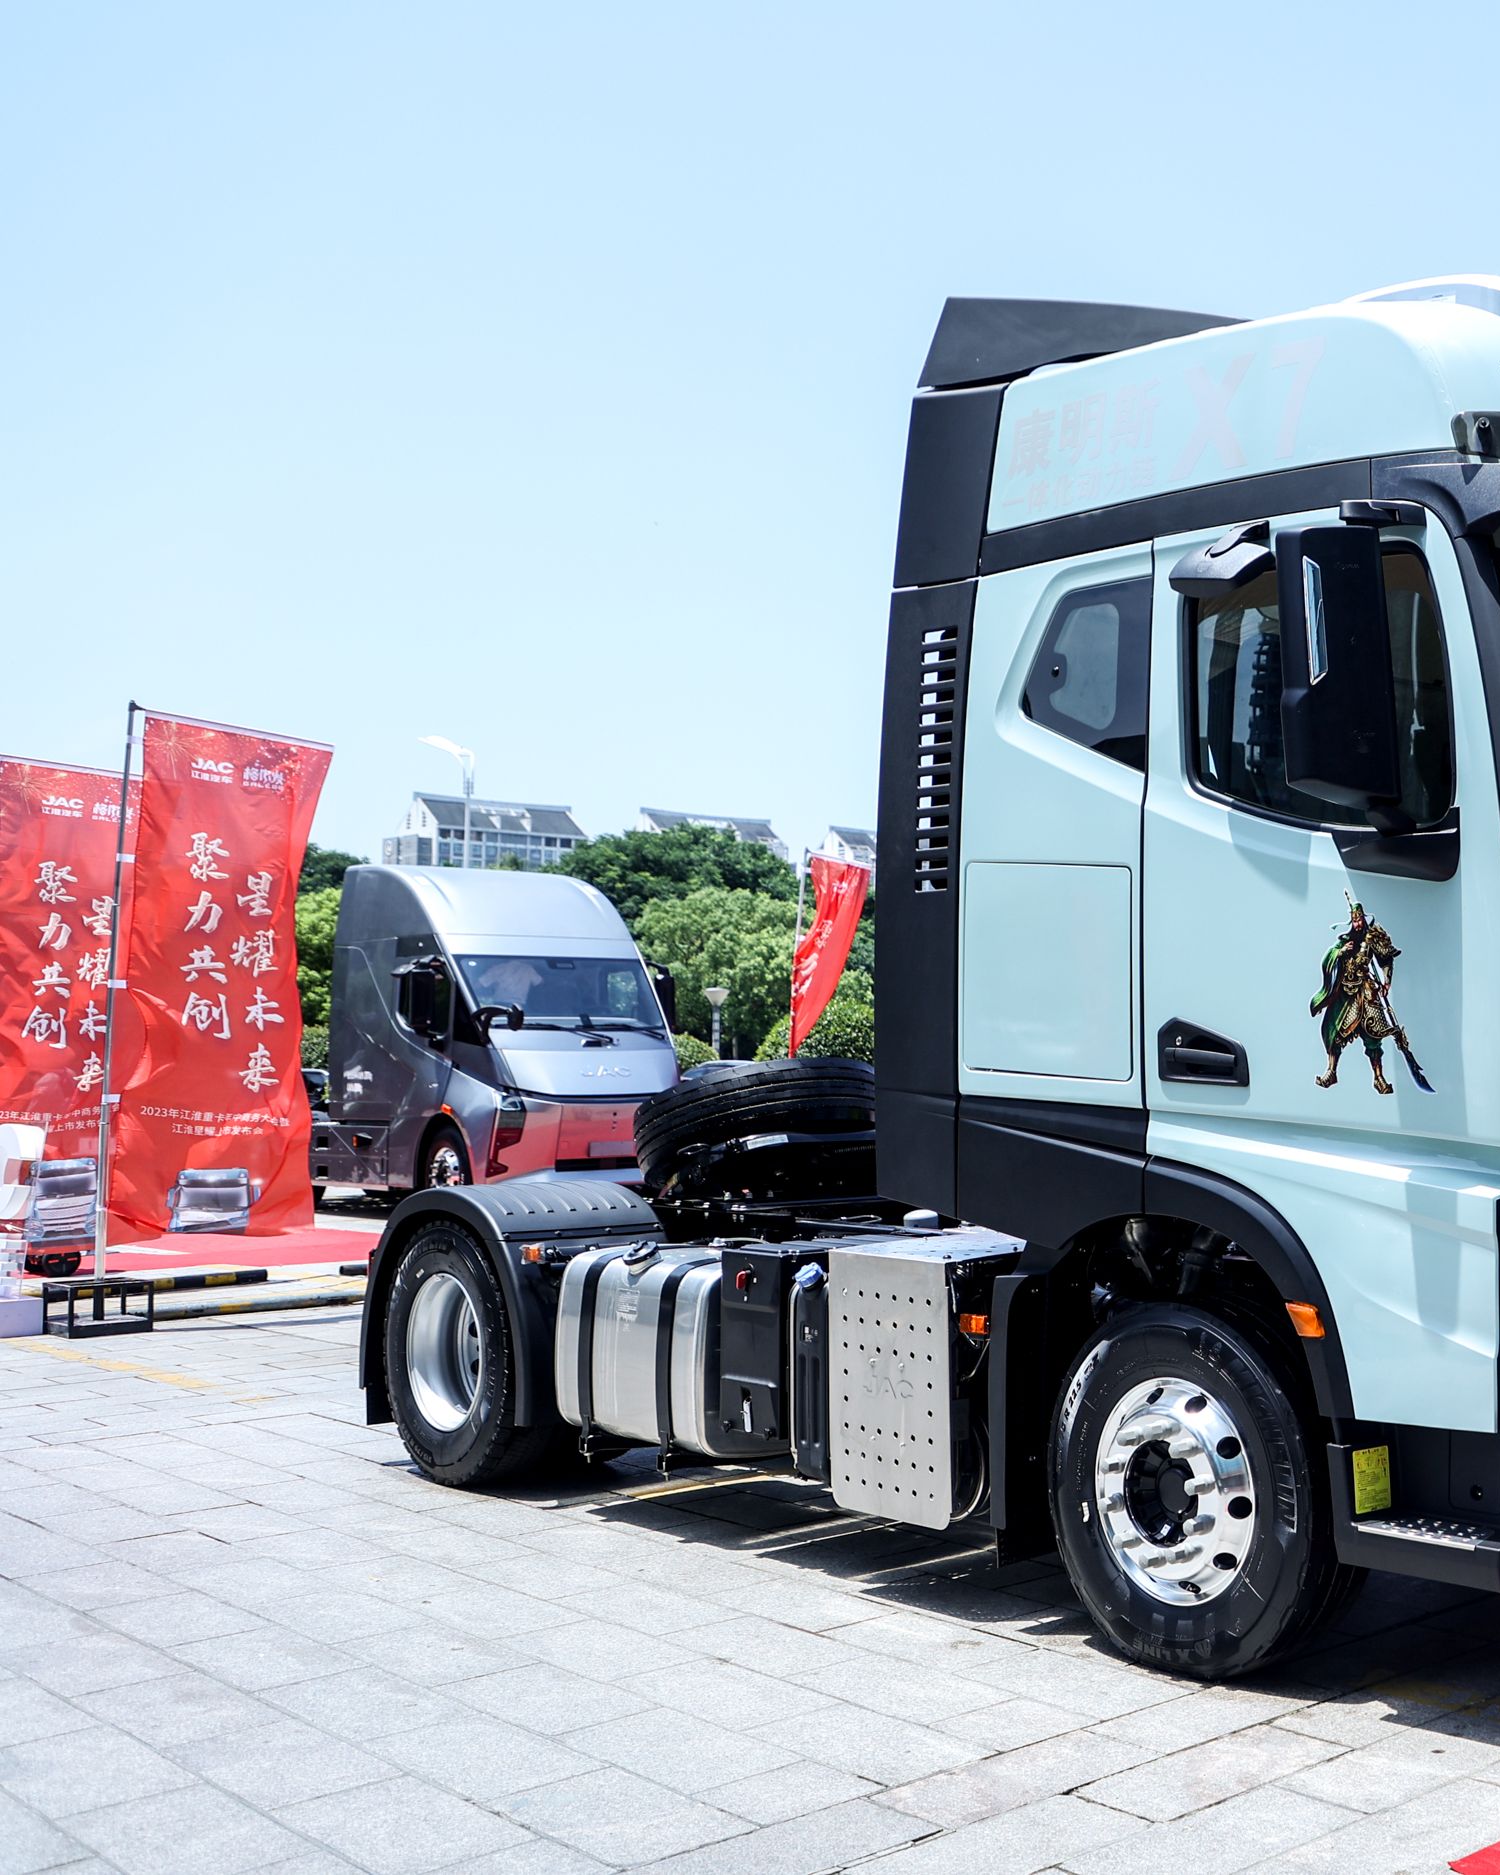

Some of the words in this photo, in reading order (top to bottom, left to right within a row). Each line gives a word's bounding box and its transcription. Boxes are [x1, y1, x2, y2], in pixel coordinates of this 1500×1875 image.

[1009, 378, 1160, 478] 康明斯
[1168, 337, 1325, 483] X7
[42, 795, 84, 809] JAC
[191, 757, 235, 774] JAC
[21, 861, 78, 1049] 聚力共创
[179, 832, 232, 1040] 聚力共创
[229, 871, 286, 1094] 星耀未来
